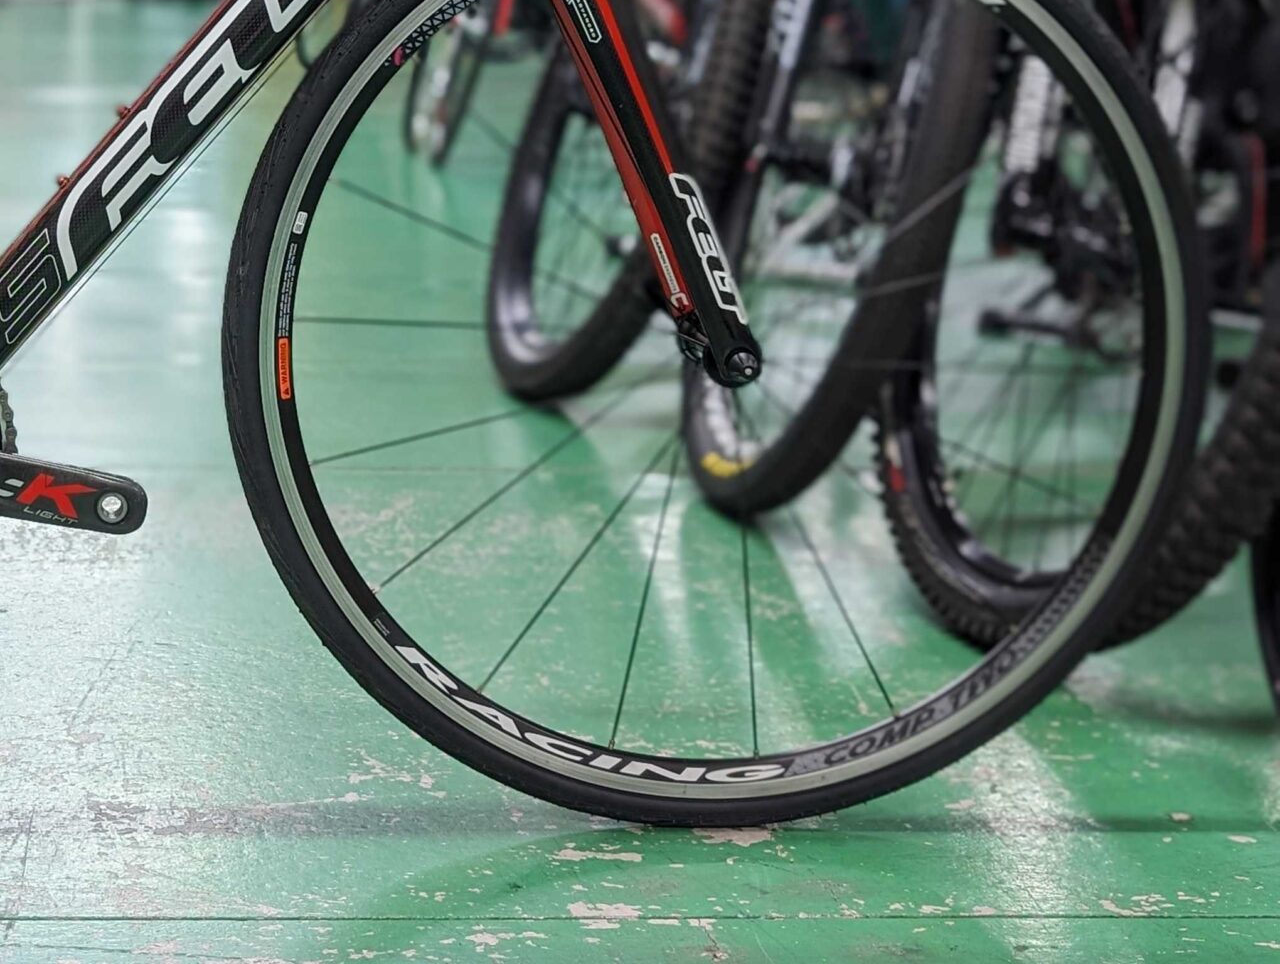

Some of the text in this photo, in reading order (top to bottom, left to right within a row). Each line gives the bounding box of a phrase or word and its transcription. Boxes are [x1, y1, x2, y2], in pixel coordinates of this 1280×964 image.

[669, 172, 749, 325] FELT
[23, 505, 79, 525] LIGHT
[393, 644, 788, 783] RACING
[824, 707, 936, 766] COMP
